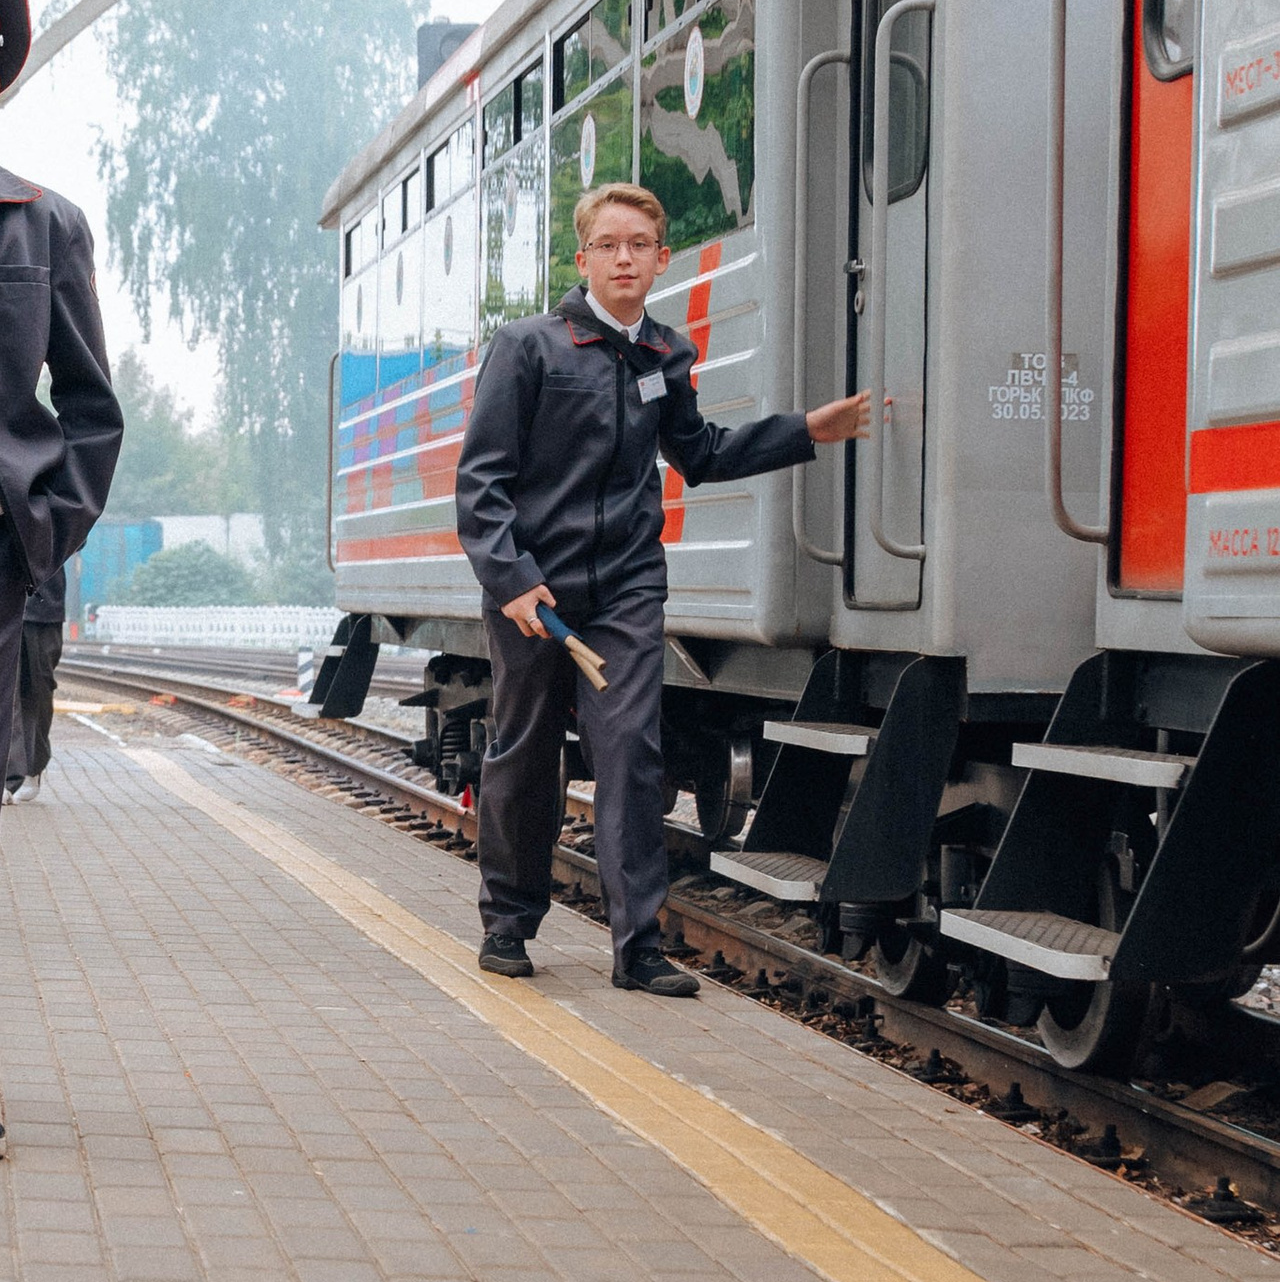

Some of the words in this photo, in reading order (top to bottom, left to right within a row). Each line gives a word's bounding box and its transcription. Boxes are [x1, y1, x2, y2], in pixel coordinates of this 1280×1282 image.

[1005, 370, 1079, 386] ЛВЧ-4
[992, 403, 1091, 420] 30.05.023
[1208, 528, 1260, 558] МАССА
